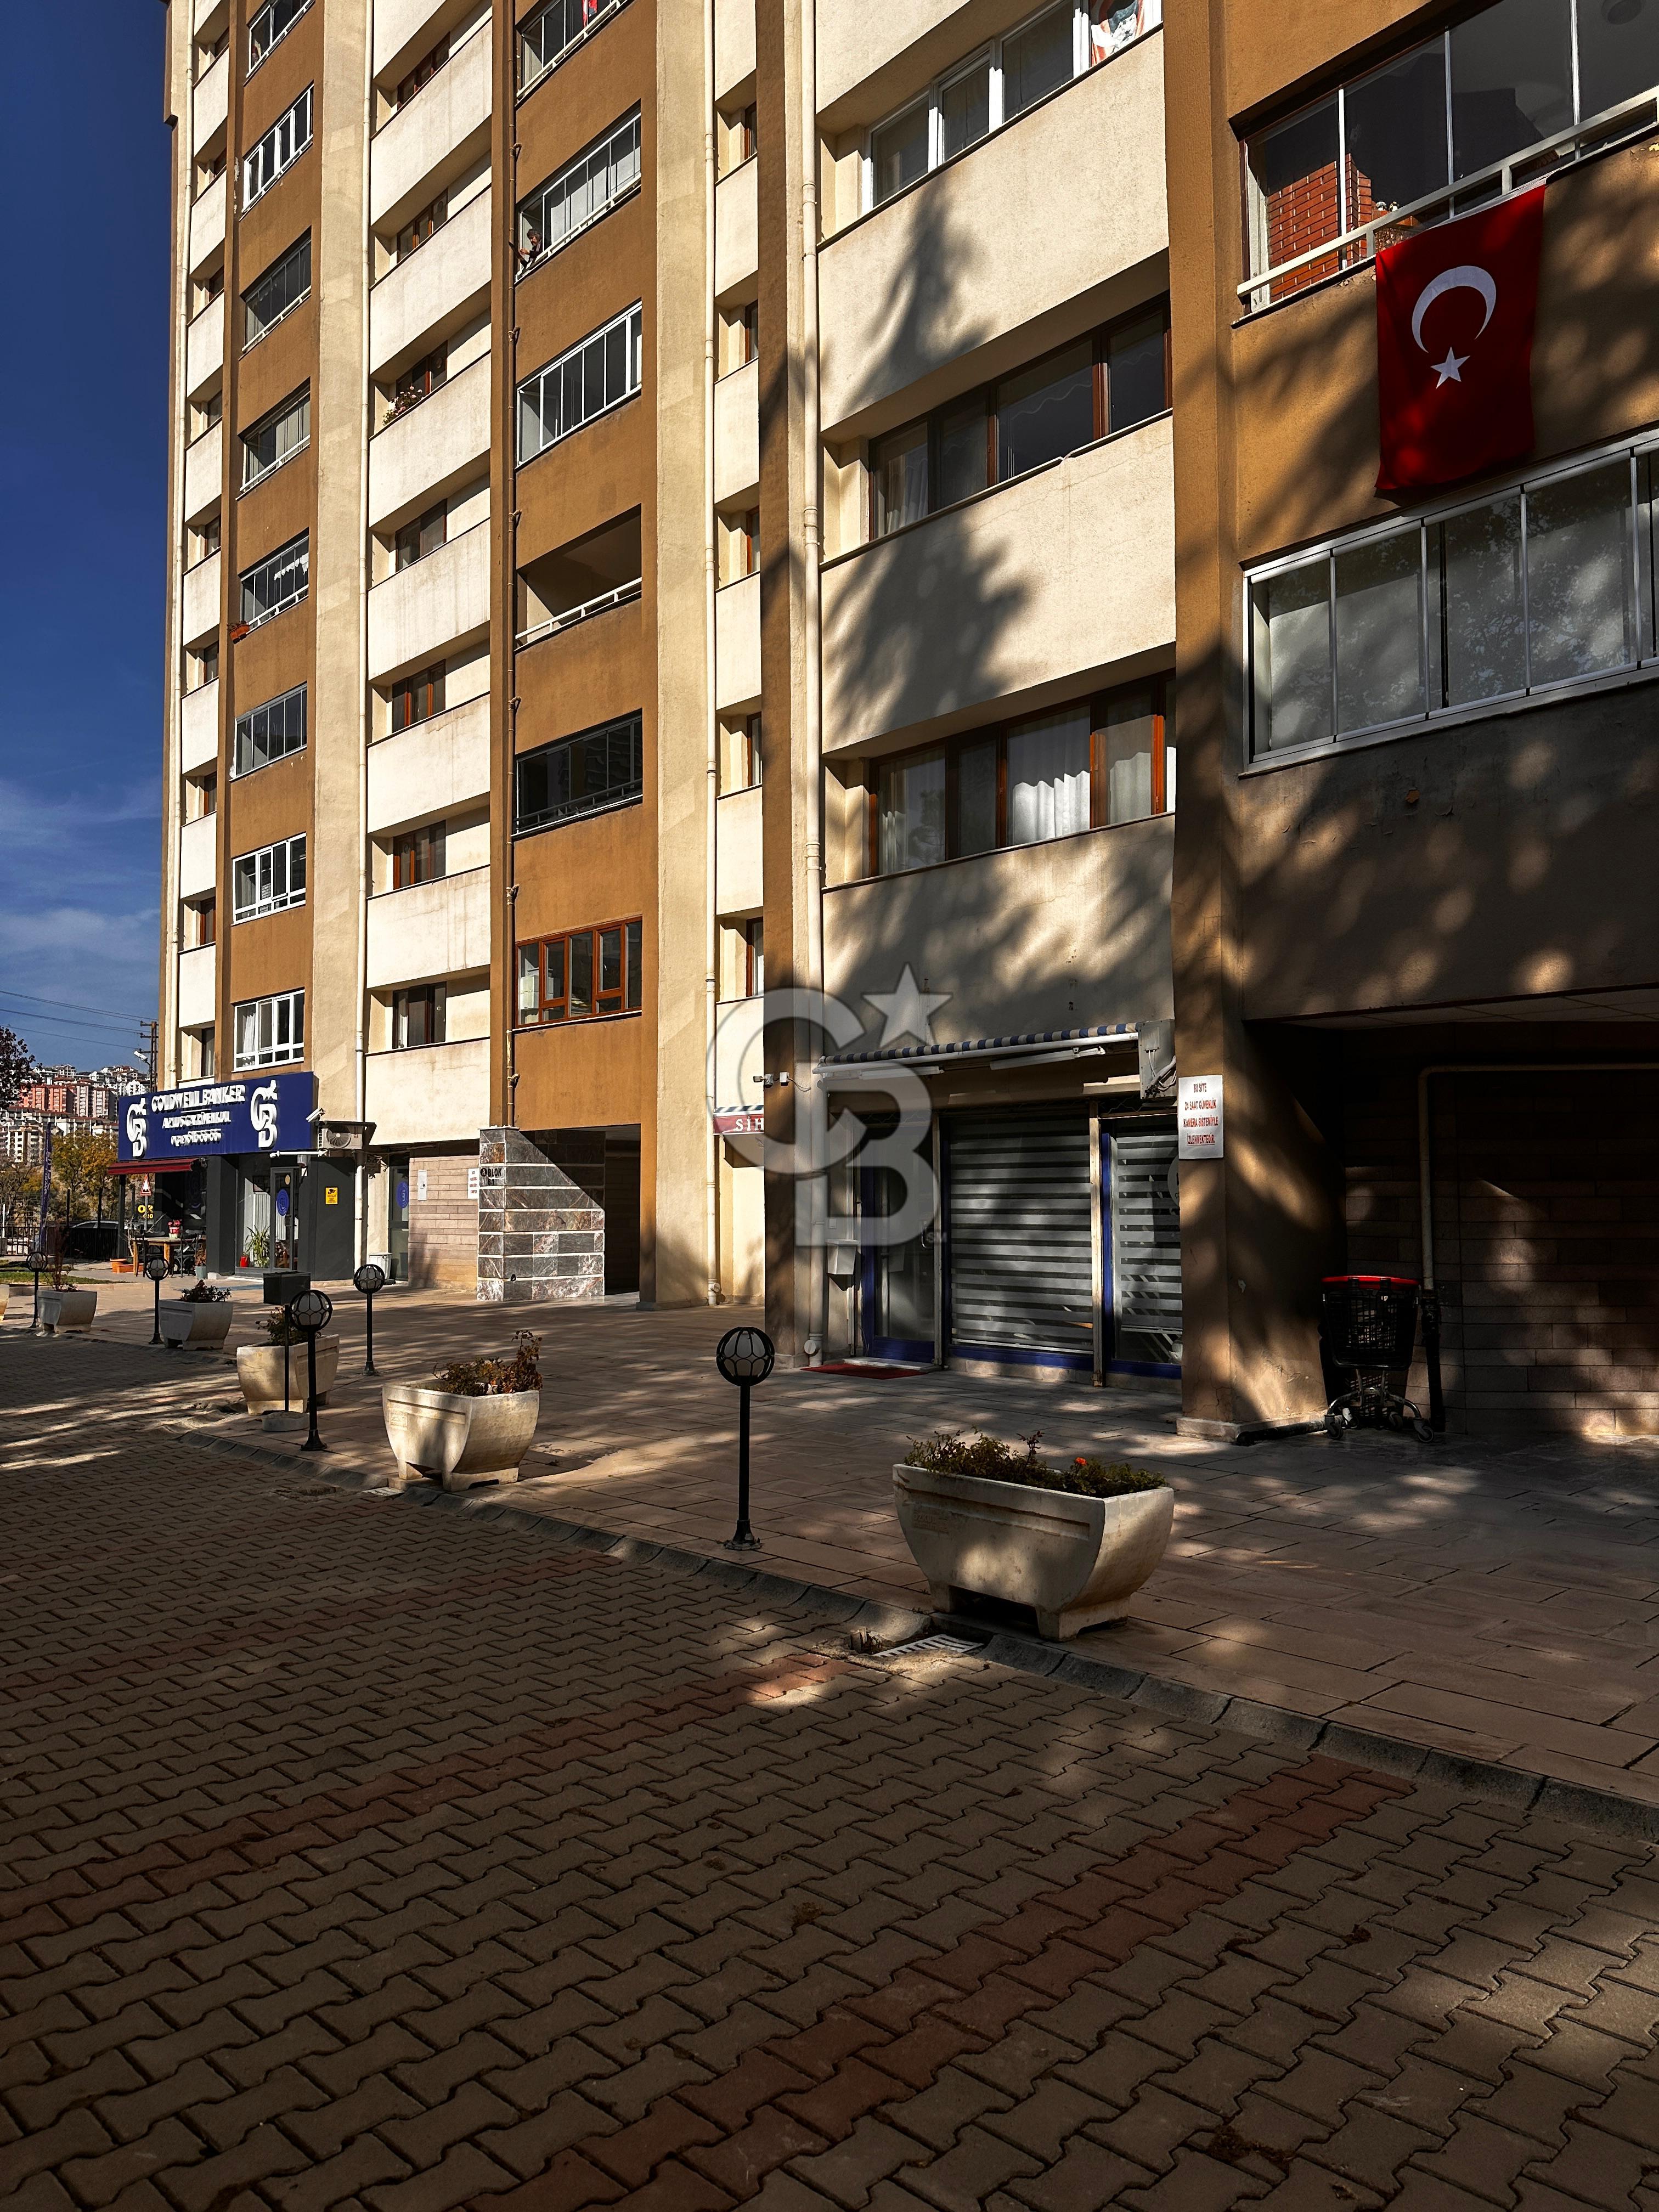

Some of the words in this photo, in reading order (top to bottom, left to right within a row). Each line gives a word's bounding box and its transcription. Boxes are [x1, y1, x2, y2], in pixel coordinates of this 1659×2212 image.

[151, 1090, 202, 1112] COLDWELL
[202, 1085, 246, 1105] BANKER
[1190, 1101, 1198, 1110] SAAT
[1199, 1097, 1216, 1109] GÜVENLİK
[1183, 1118, 1197, 1127] KAMERA
[1199, 1115, 1218, 1127] SİSTEMİYLE
[488, 1168, 501, 1177] BLOK
